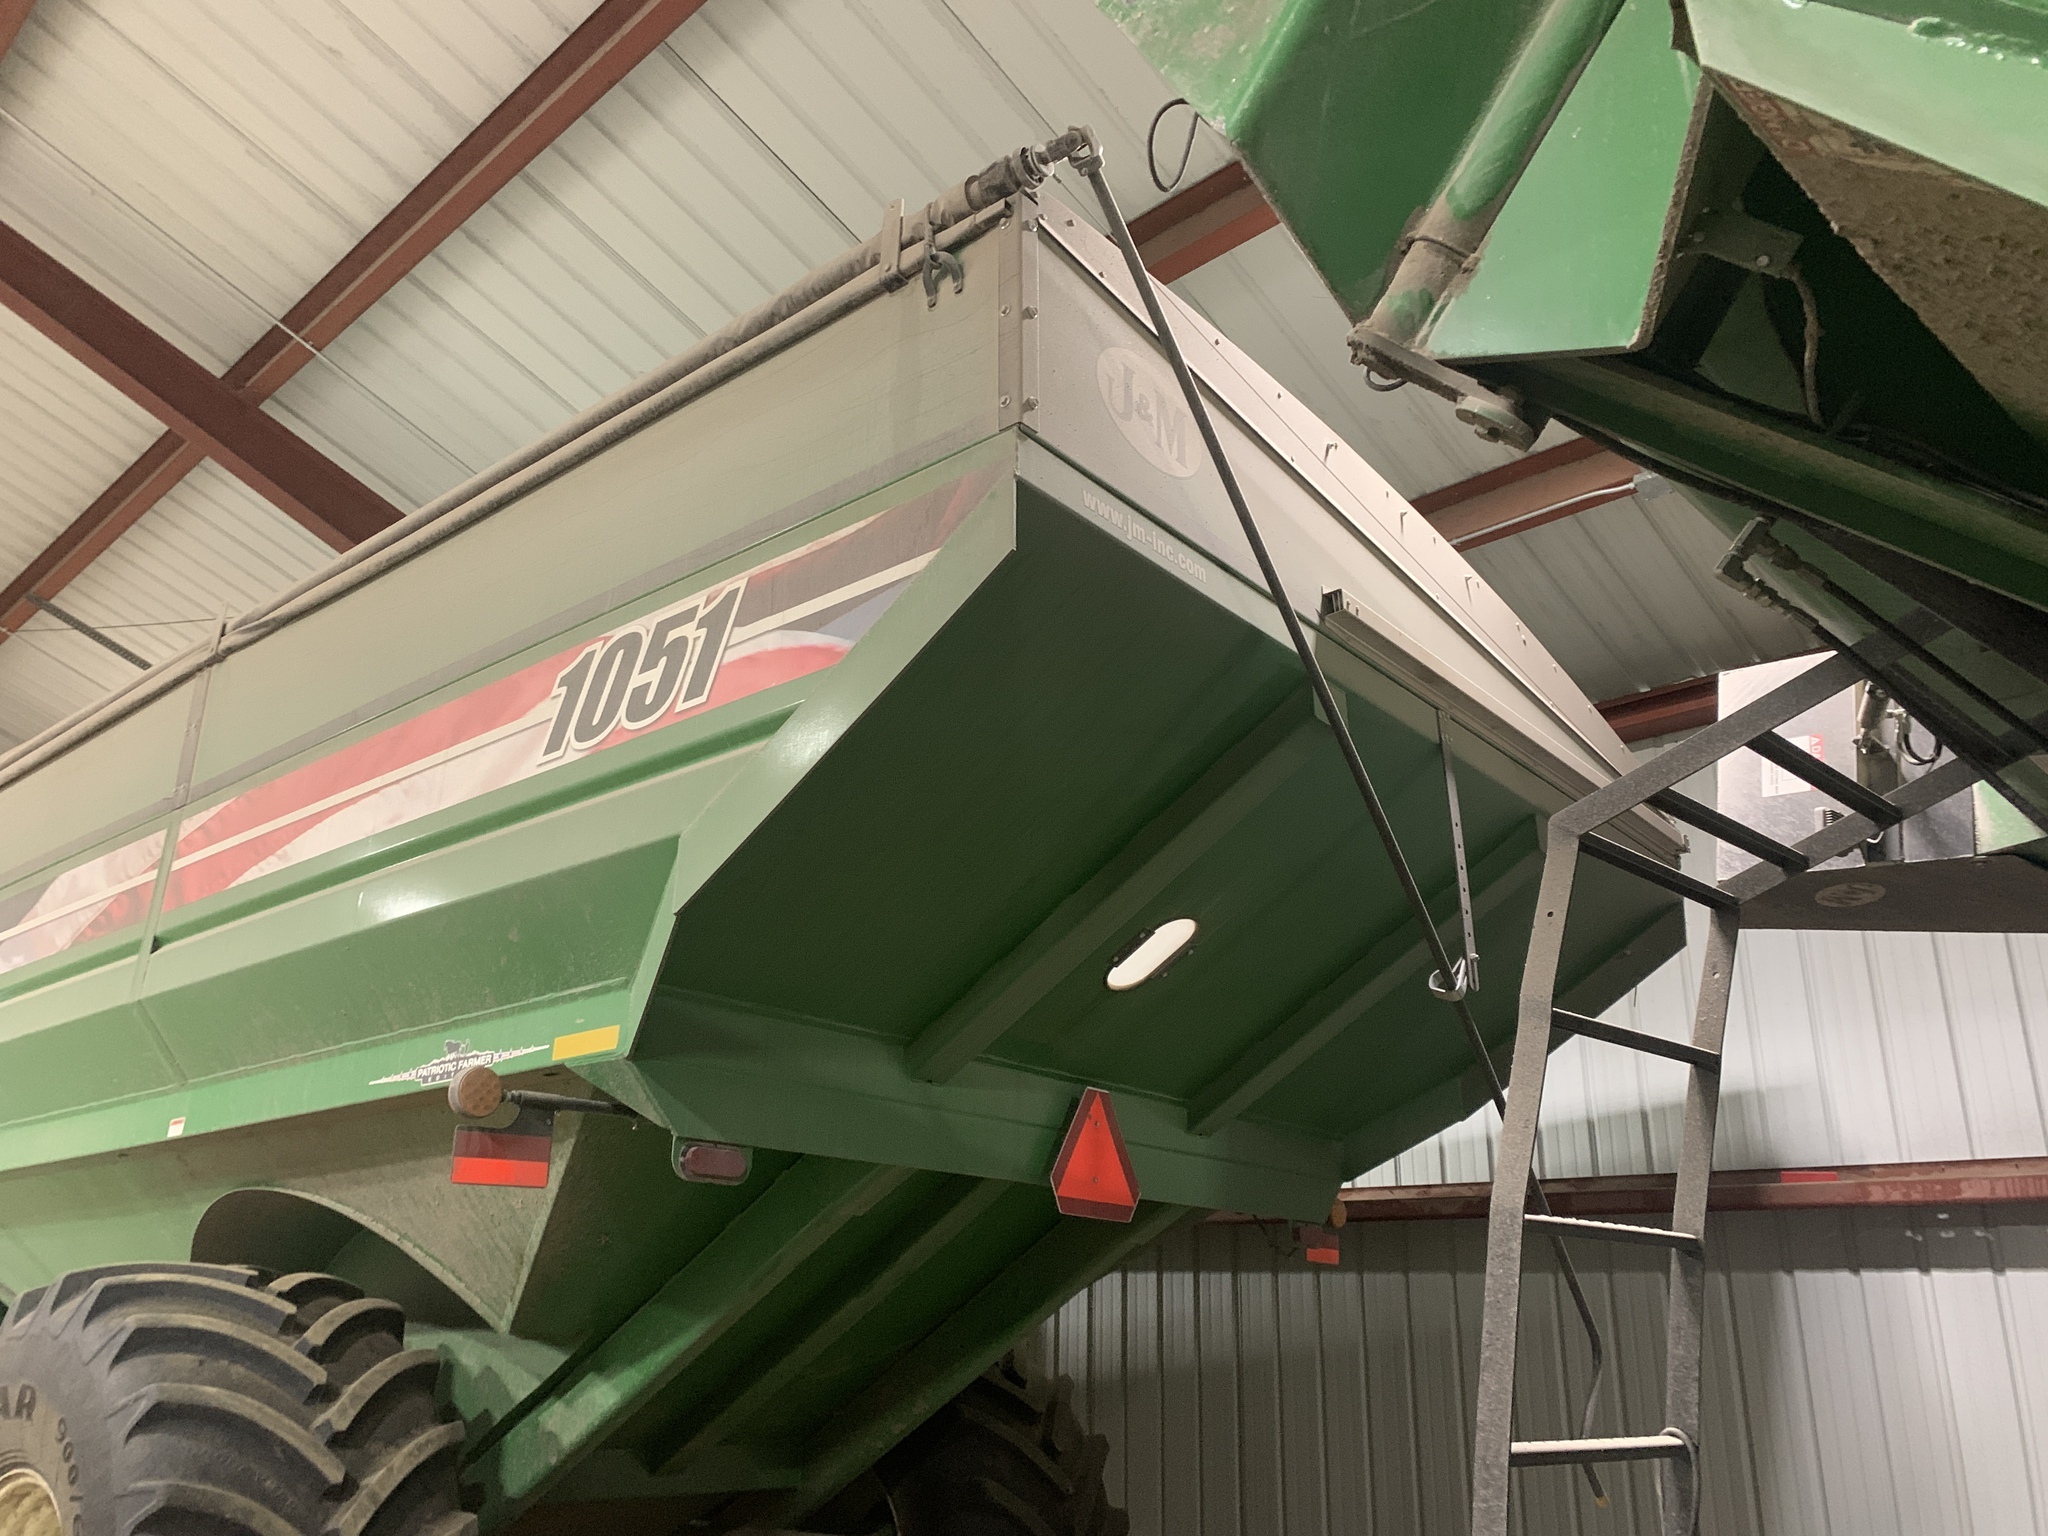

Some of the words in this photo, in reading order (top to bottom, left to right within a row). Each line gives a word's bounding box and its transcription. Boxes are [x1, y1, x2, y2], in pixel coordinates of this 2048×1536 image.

[1105, 362, 1189, 470] J&M
[1082, 490, 1207, 584] www.jm-inc.com
[537, 578, 748, 766] 1051
[417, 1062, 457, 1078] PATRIOTIC
[457, 1054, 492, 1070] FARMER
[427, 1072, 456, 1083] EDIT
